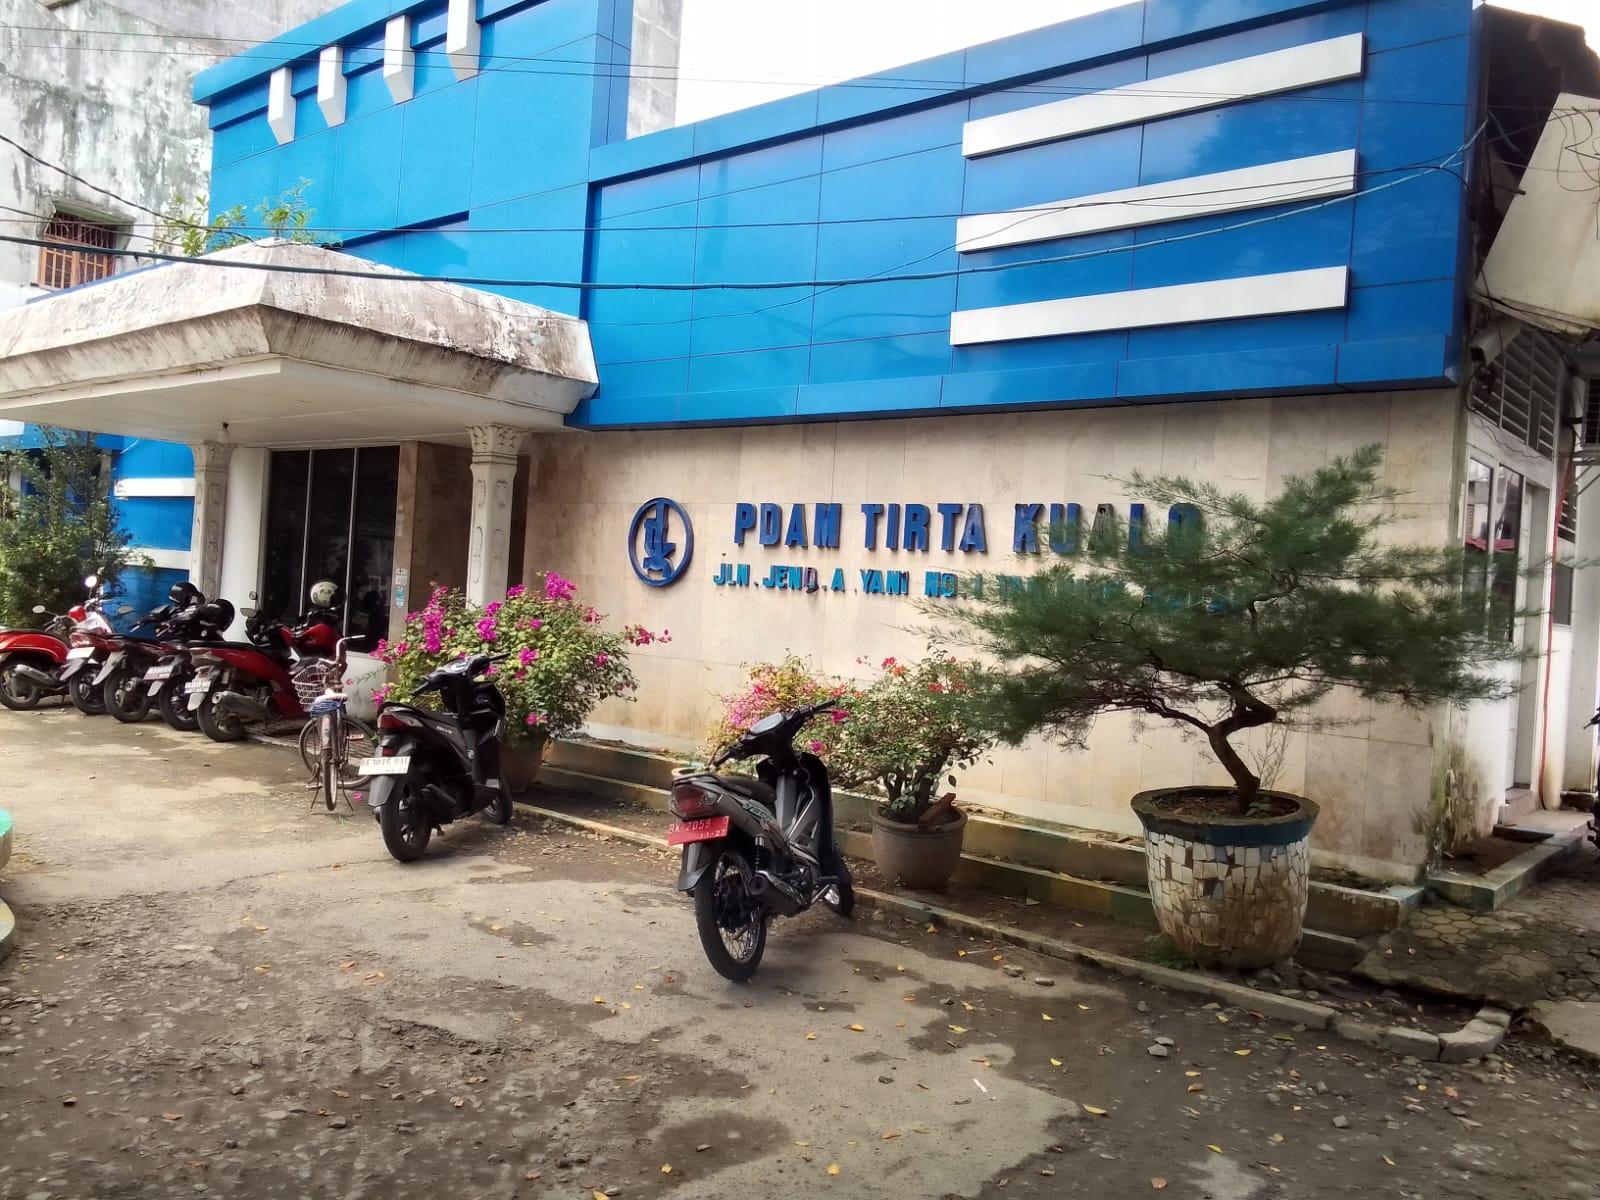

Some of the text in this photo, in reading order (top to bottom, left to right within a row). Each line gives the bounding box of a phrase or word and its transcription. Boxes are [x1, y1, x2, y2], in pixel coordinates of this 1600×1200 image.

[734, 502, 843, 549] PDAM
[861, 503, 987, 552] TIRTA
[860, 568, 910, 594] YANI
